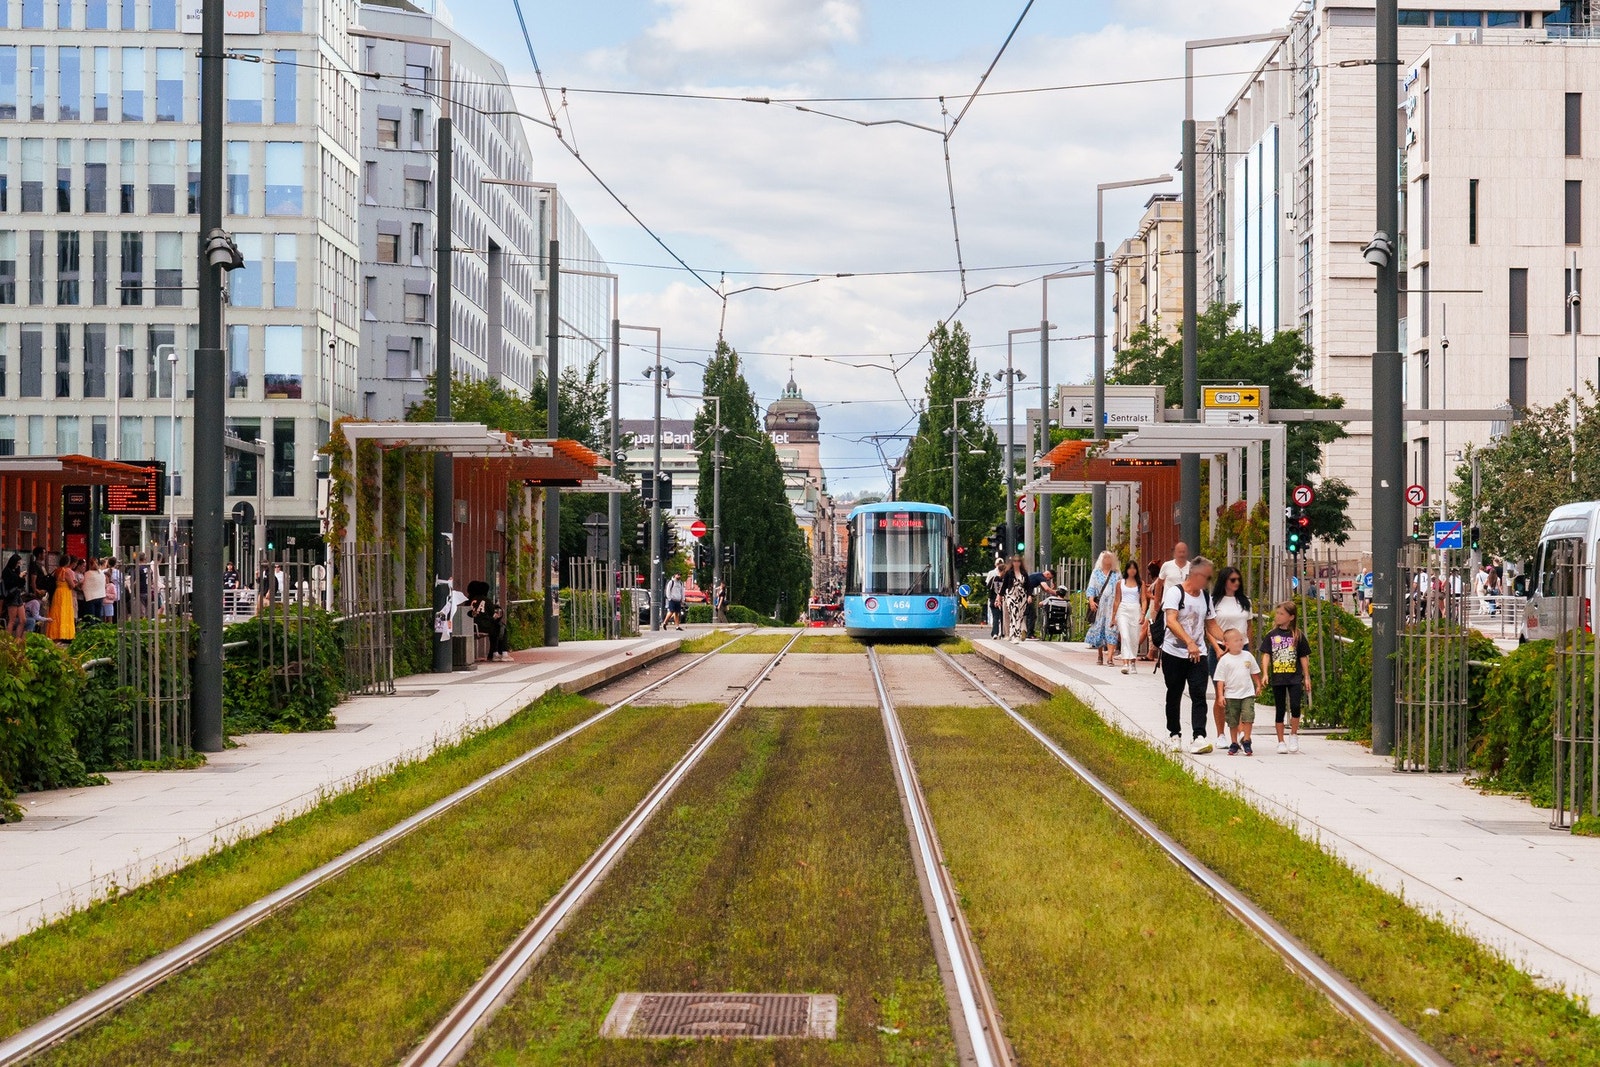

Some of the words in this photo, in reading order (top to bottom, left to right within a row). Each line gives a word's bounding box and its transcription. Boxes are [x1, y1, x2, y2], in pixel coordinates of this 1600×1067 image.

[1218, 394, 1231, 402] Ring
[879, 519, 888, 528] 19
[893, 600, 911, 609] 464
